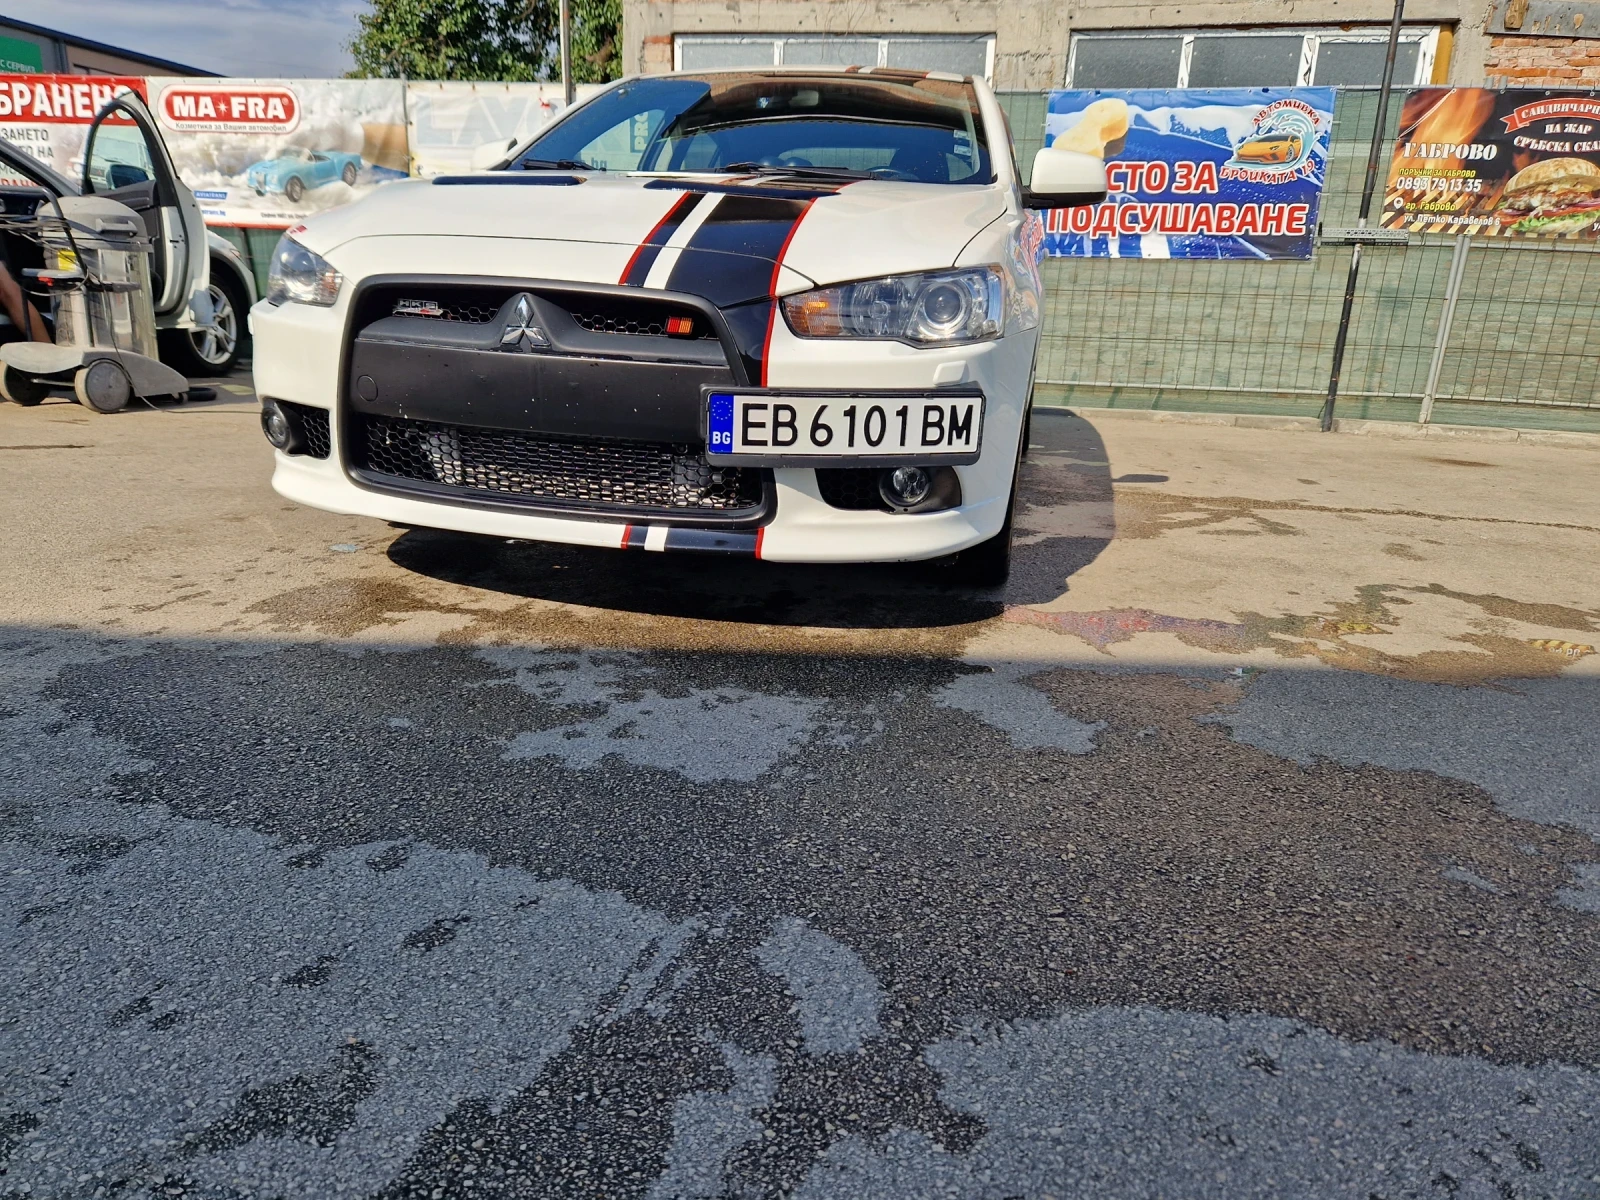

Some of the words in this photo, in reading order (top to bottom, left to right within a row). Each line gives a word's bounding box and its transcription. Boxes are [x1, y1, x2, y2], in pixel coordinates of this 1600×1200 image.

[1252, 100, 1321, 126] АВТОМИВКА
[1521, 103, 1600, 119] САНДВИЧАРН
[175, 123, 212, 131] Козметика
[248, 124, 287, 132] автомобил
[1545, 123, 1562, 134] НА
[1564, 123, 1593, 135] ЖАР
[1403, 143, 1498, 160] ГАБРОВО
[1513, 136, 1571, 152] СРЪБСКА
[1301, 161, 1315, 176] 19
[1399, 168, 1432, 177] ПОРЪЧКИ
[1444, 169, 1476, 177] ГАБРОВО
[1174, 162, 1219, 194] ЗА
[1396, 177, 1428, 191] 0893
[1431, 178, 1446, 191] 79
[1449, 178, 1464, 191] 13
[1465, 179, 1483, 192] 35
[1420, 201, 1456, 212] Габрово
[1047, 203, 1309, 238] ПОДСУШАВАНЕ
[1417, 214, 1446, 224] Петко
[1448, 214, 1493, 226] Каравелов
[712, 431, 731, 445] BG
